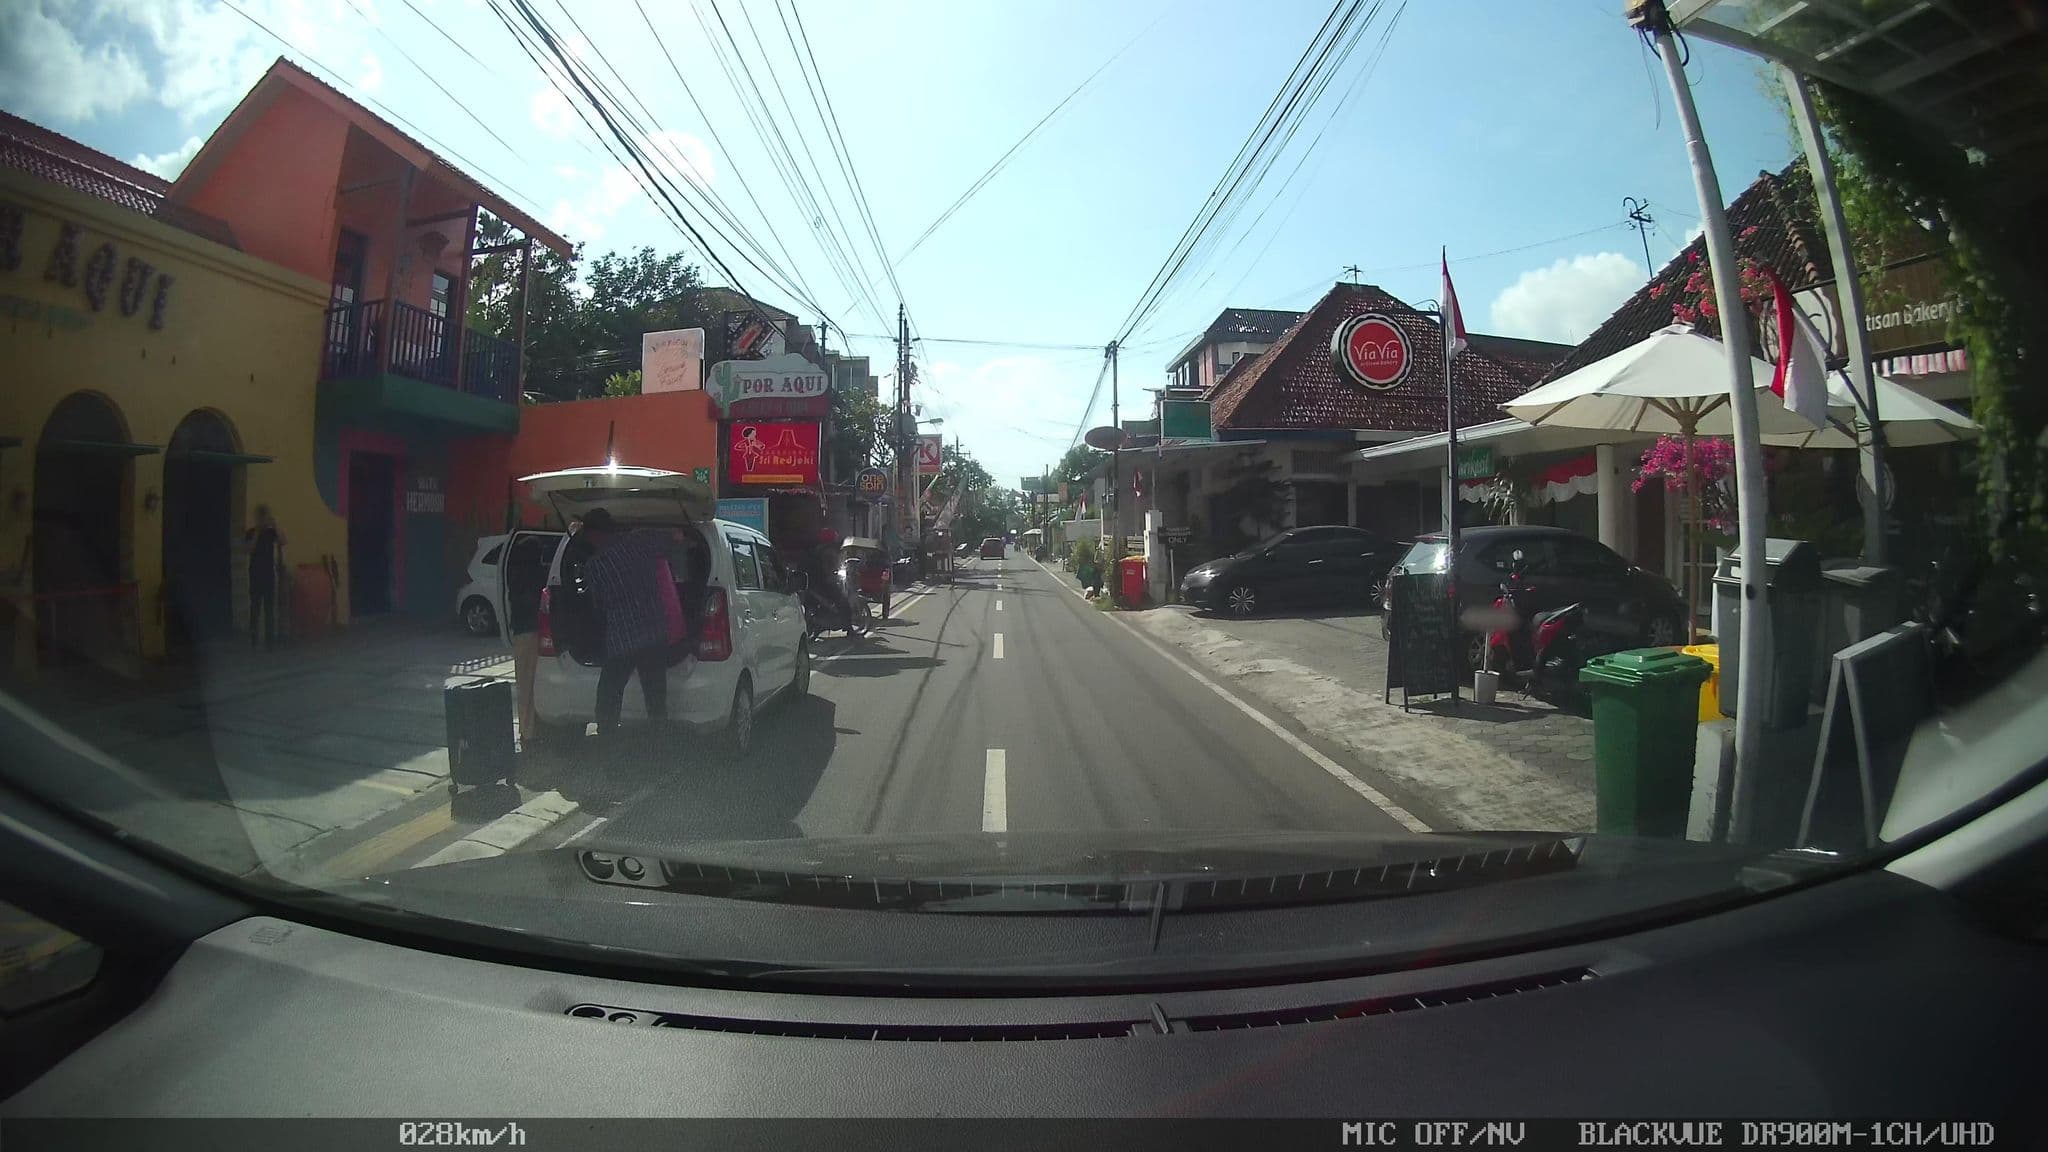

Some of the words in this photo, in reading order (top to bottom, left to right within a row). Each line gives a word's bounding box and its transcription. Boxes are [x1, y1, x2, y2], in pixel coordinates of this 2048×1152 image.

[44, 219, 174, 330] AQUI
[1864, 311, 1901, 332] tisan
[1903, 300, 1953, 326] Bakery
[1353, 339, 1400, 361] ViaVia
[743, 377, 774, 394] POR
[780, 375, 823, 394] AQUI
[861, 481, 884, 492] spin
[862, 473, 884, 483] one
